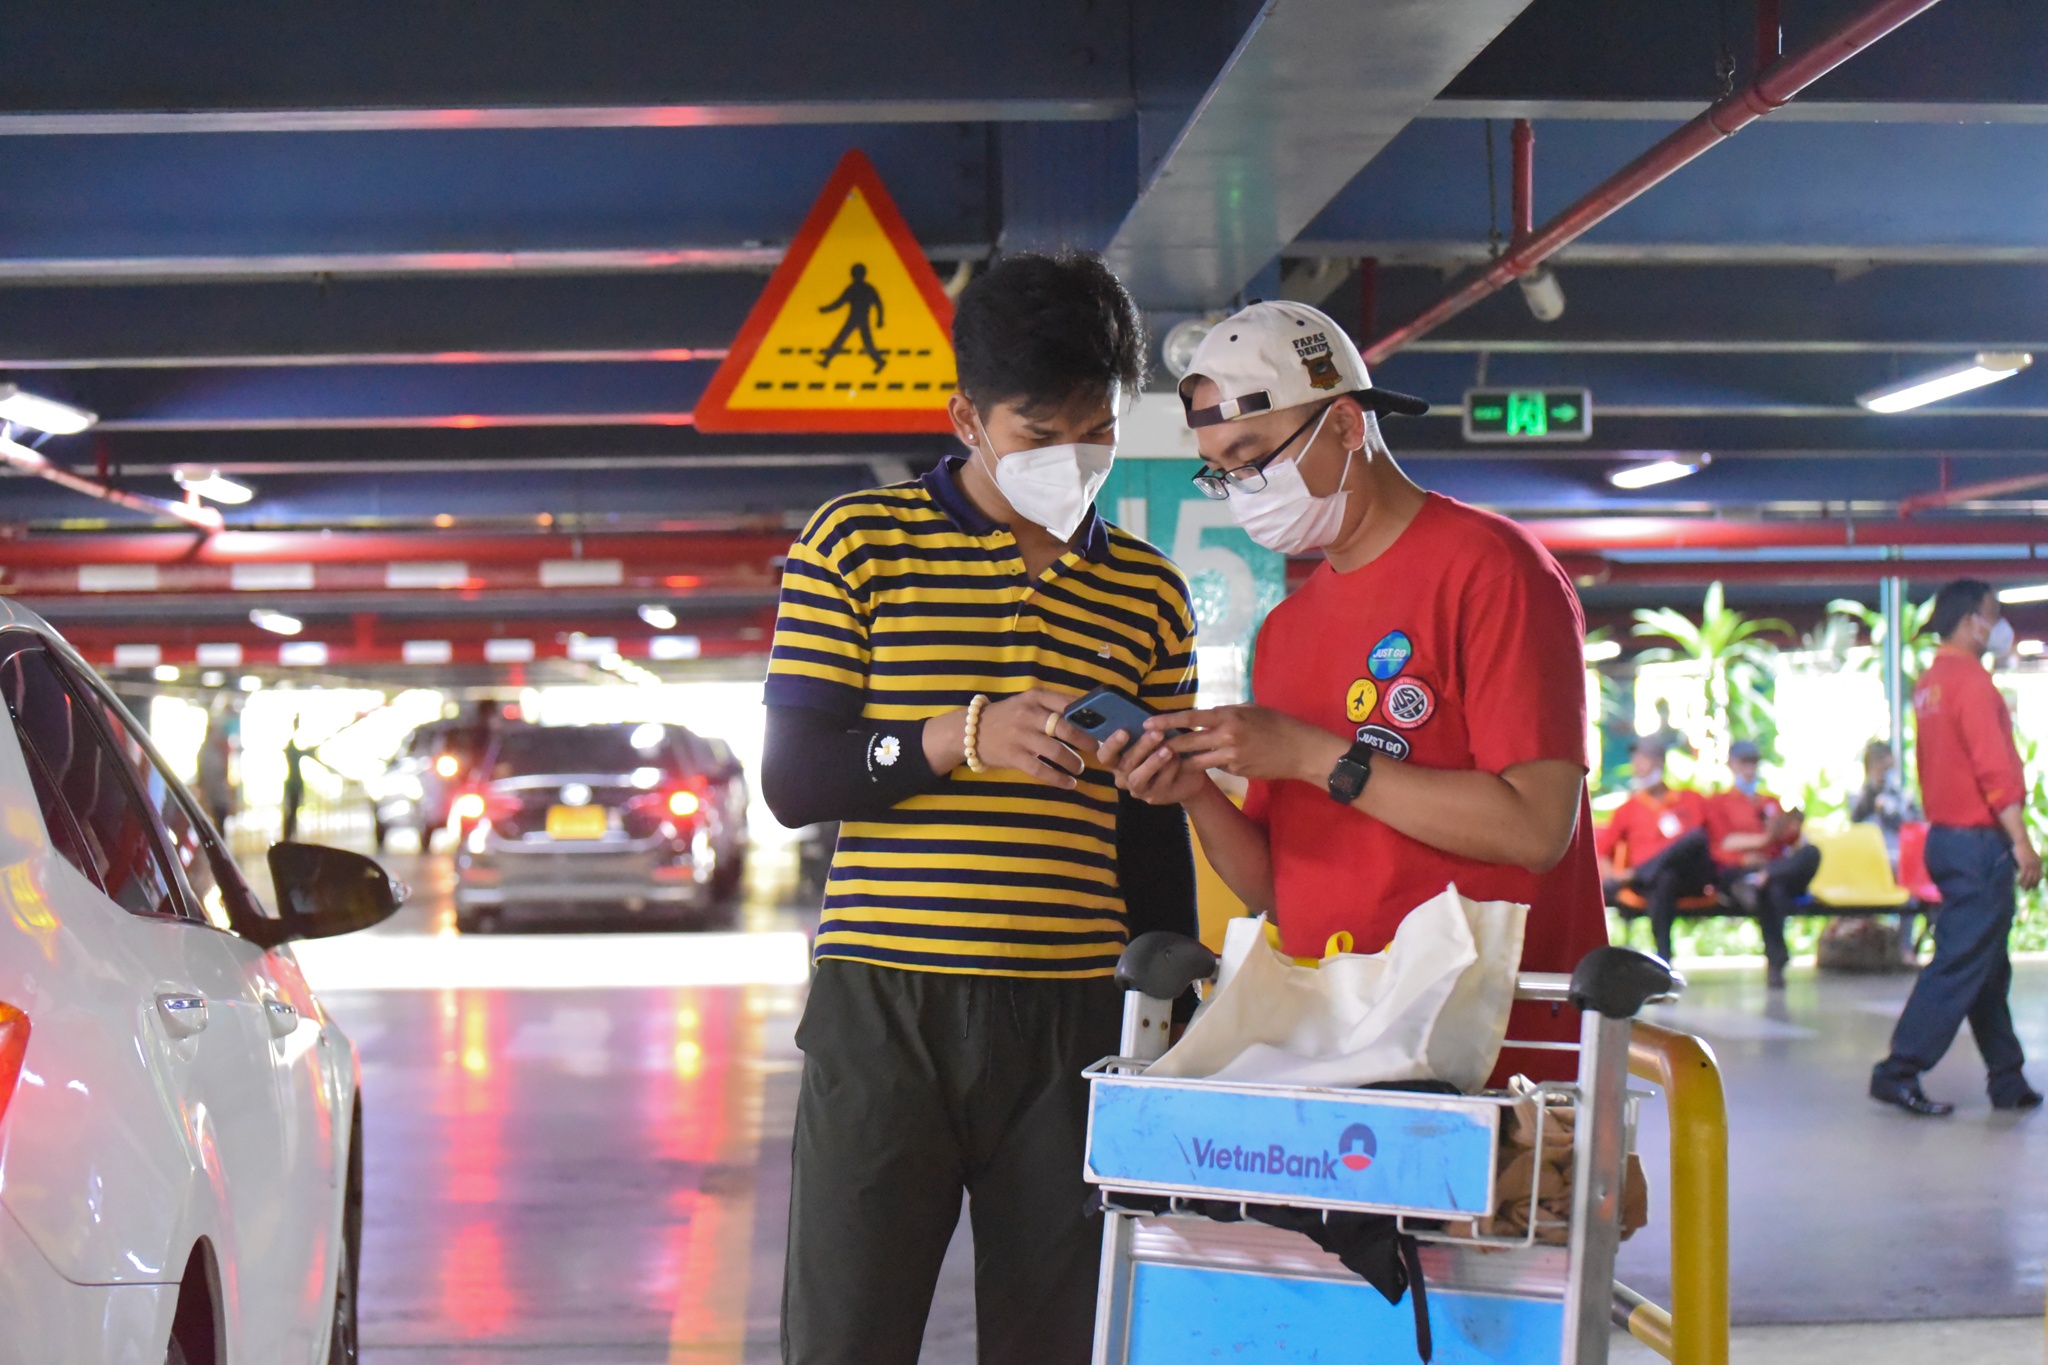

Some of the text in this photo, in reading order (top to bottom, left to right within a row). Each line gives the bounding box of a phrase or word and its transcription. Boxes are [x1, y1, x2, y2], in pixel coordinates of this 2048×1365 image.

[1373, 648, 1407, 658] JUST GO
[1391, 687, 1420, 711] JUST
[1359, 732, 1402, 754] JUST GO
[1192, 1137, 1338, 1180] VietinBank
